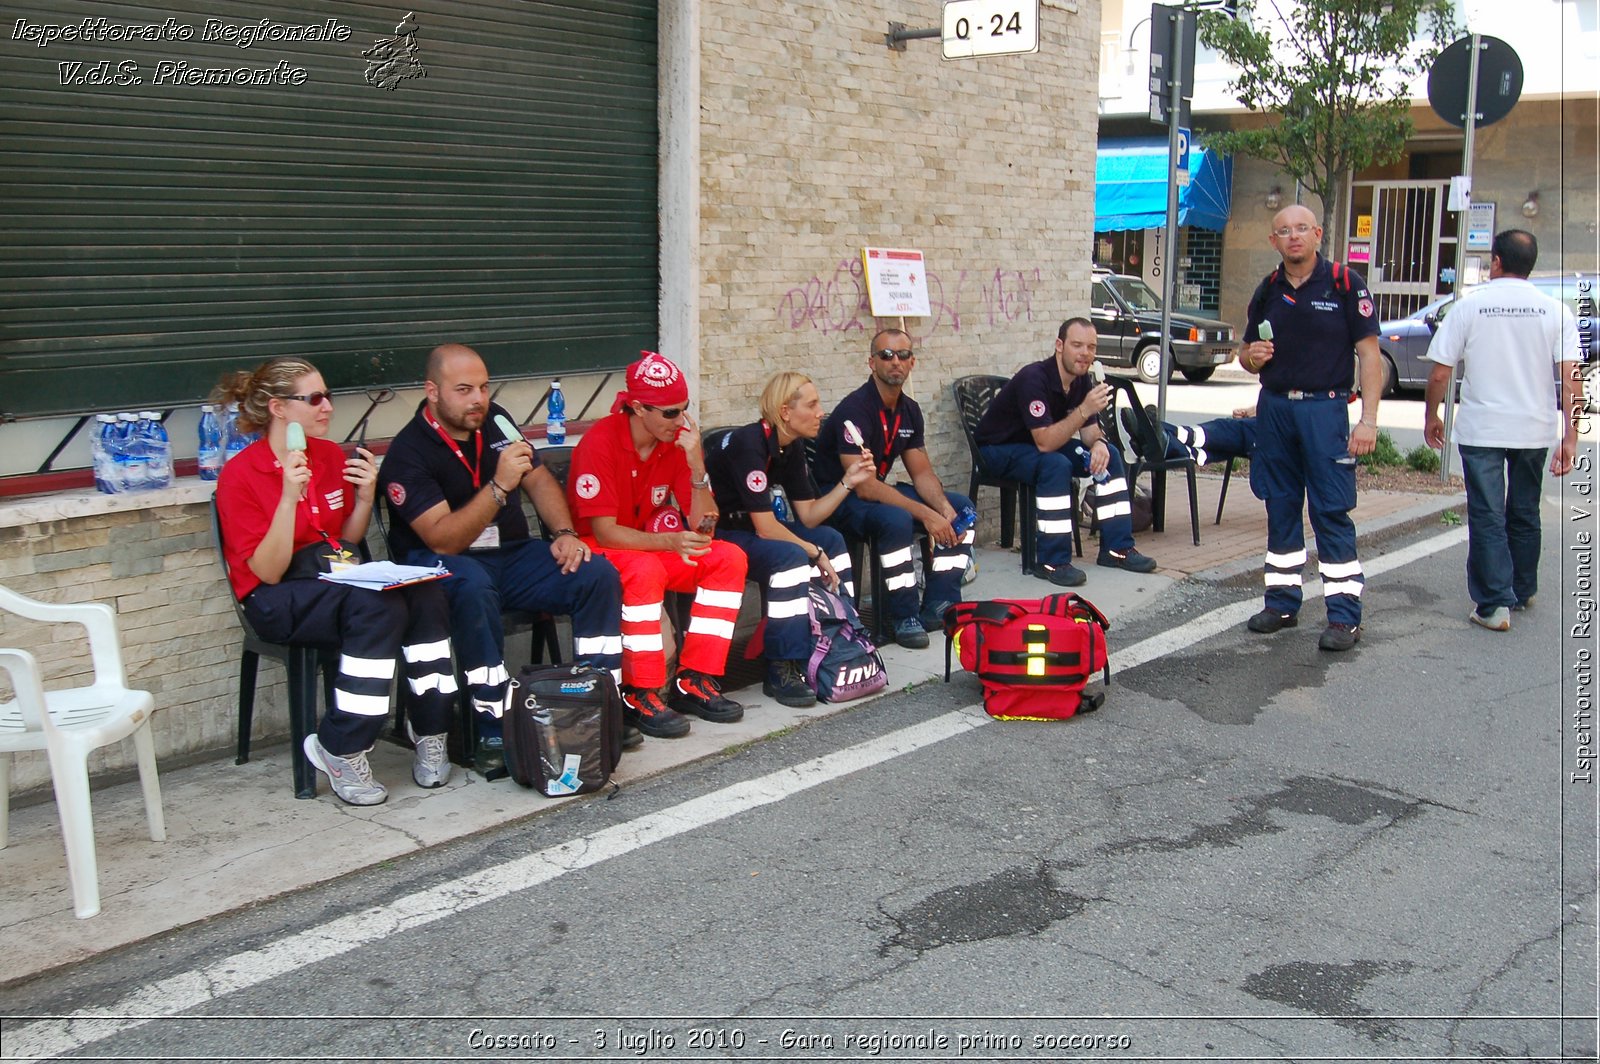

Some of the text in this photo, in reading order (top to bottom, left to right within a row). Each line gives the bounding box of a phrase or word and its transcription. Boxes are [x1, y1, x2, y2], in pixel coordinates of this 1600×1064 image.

[990, 11, 1022, 37] 24
[1177, 133, 1187, 165] P
[1479, 306, 1546, 315] RICHFIELD
